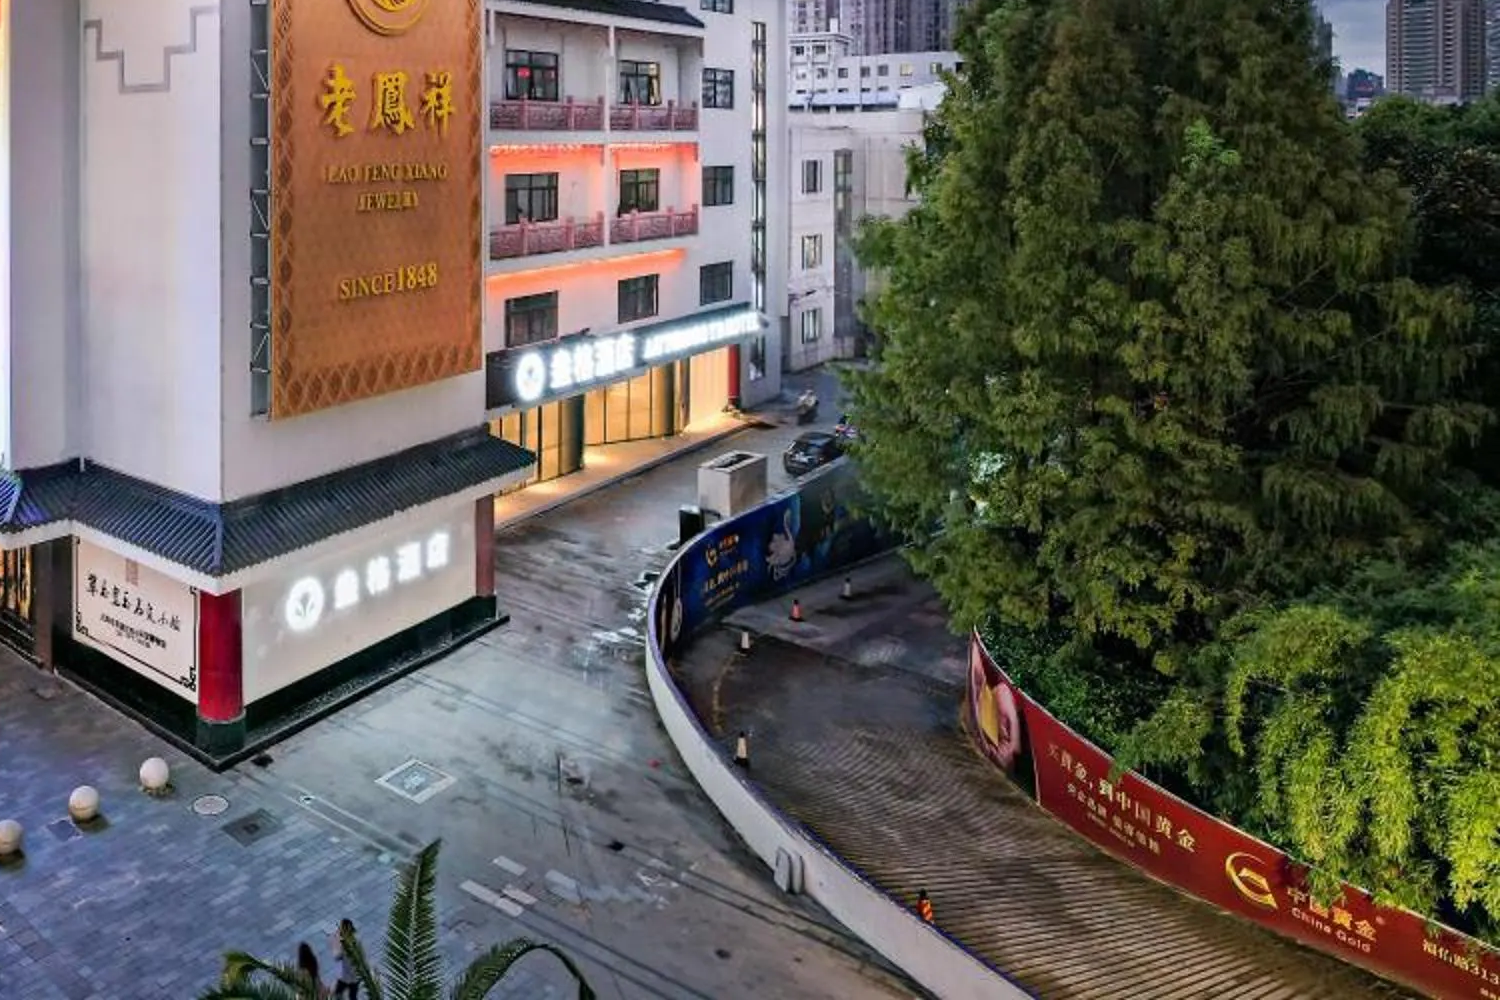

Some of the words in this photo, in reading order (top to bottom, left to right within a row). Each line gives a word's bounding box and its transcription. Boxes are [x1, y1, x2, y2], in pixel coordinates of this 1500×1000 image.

[325, 164, 359, 184] LAO
[362, 163, 399, 183] FENG
[403, 161, 448, 181] XIANG
[339, 273, 395, 300] SINCE
[397, 262, 438, 291] 1848
[1291, 907, 1331, 934] China
[1336, 930, 1371, 954] Gold
